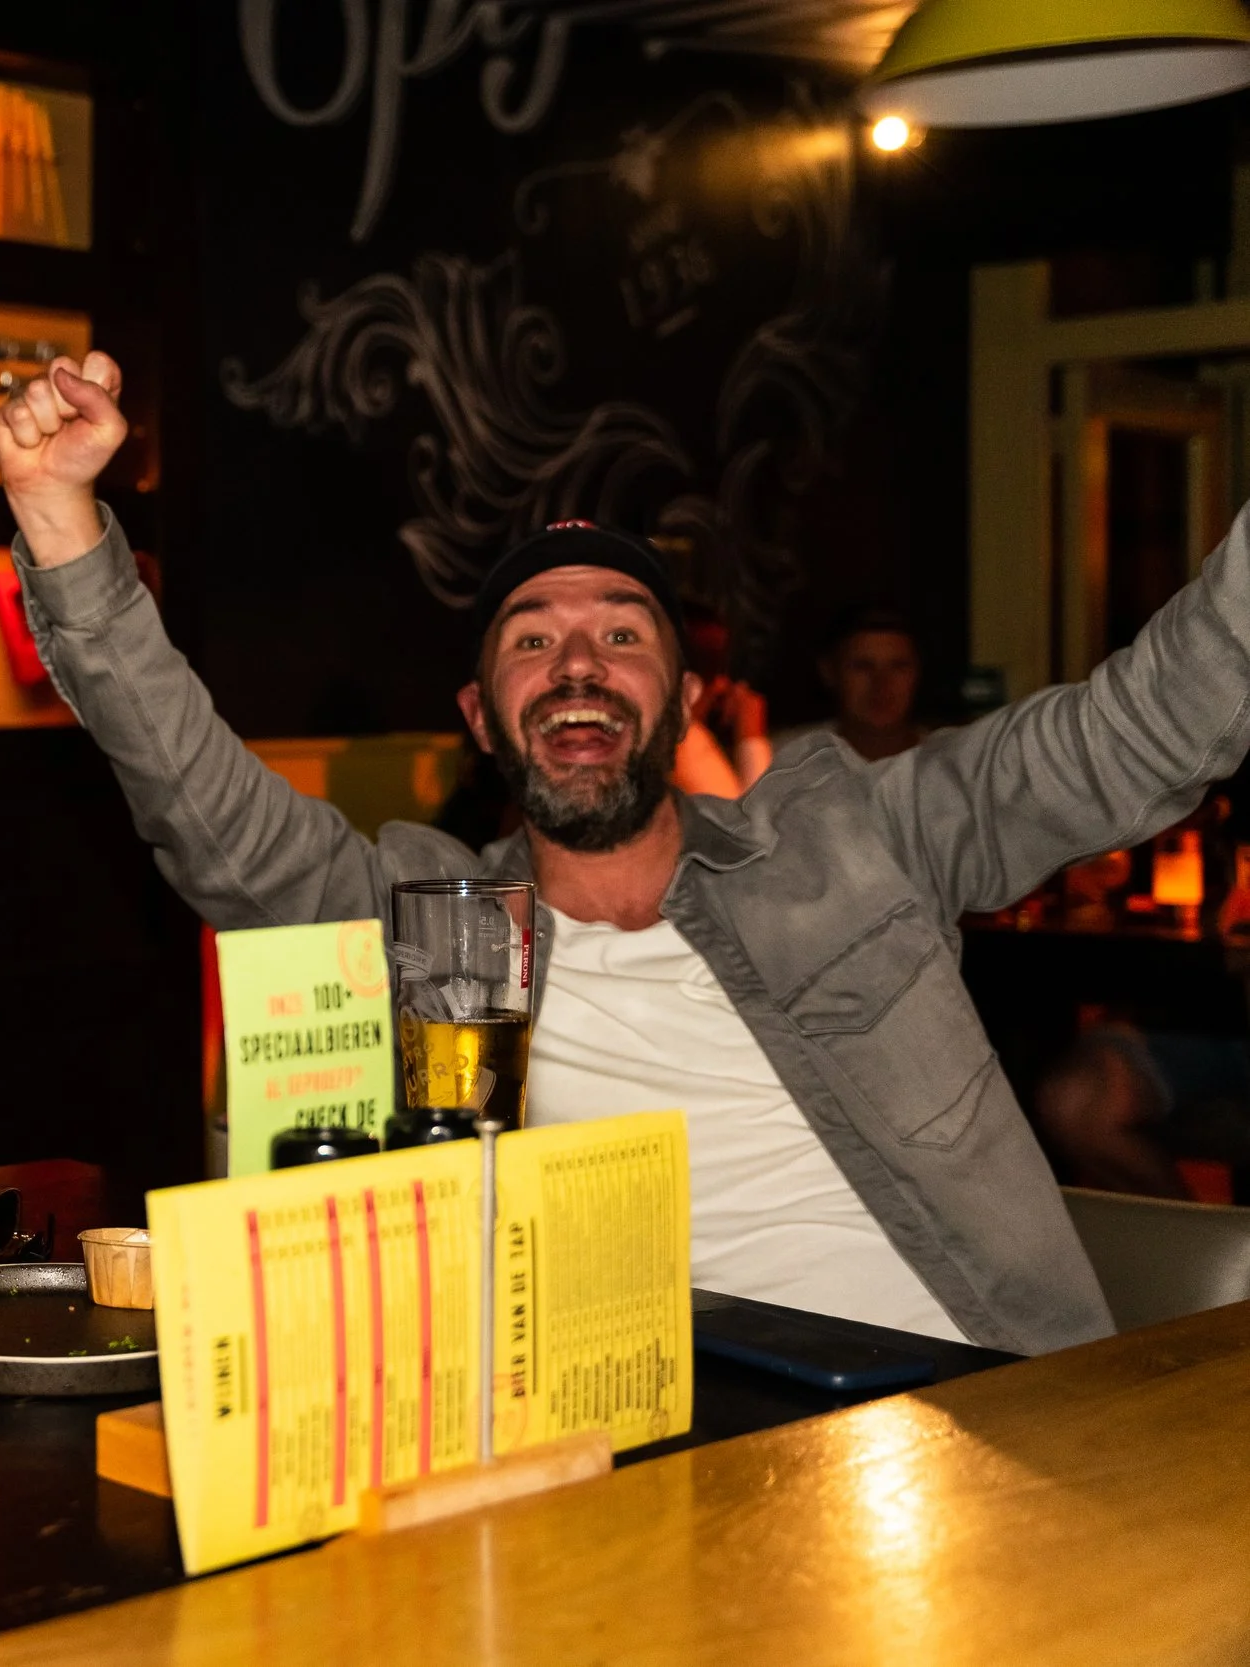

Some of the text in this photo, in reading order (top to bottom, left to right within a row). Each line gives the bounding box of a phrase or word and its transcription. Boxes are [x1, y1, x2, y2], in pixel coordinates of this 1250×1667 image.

[522, 944, 530, 983] PERONI
[239, 1018, 383, 1065] SPECIAALBIEREN
[293, 1102, 347, 1128] CHECK
[355, 1097, 377, 1127] DE
[508, 1221, 525, 1259] TAP
[509, 1270, 526, 1294] DE
[509, 1302, 526, 1344] VAN
